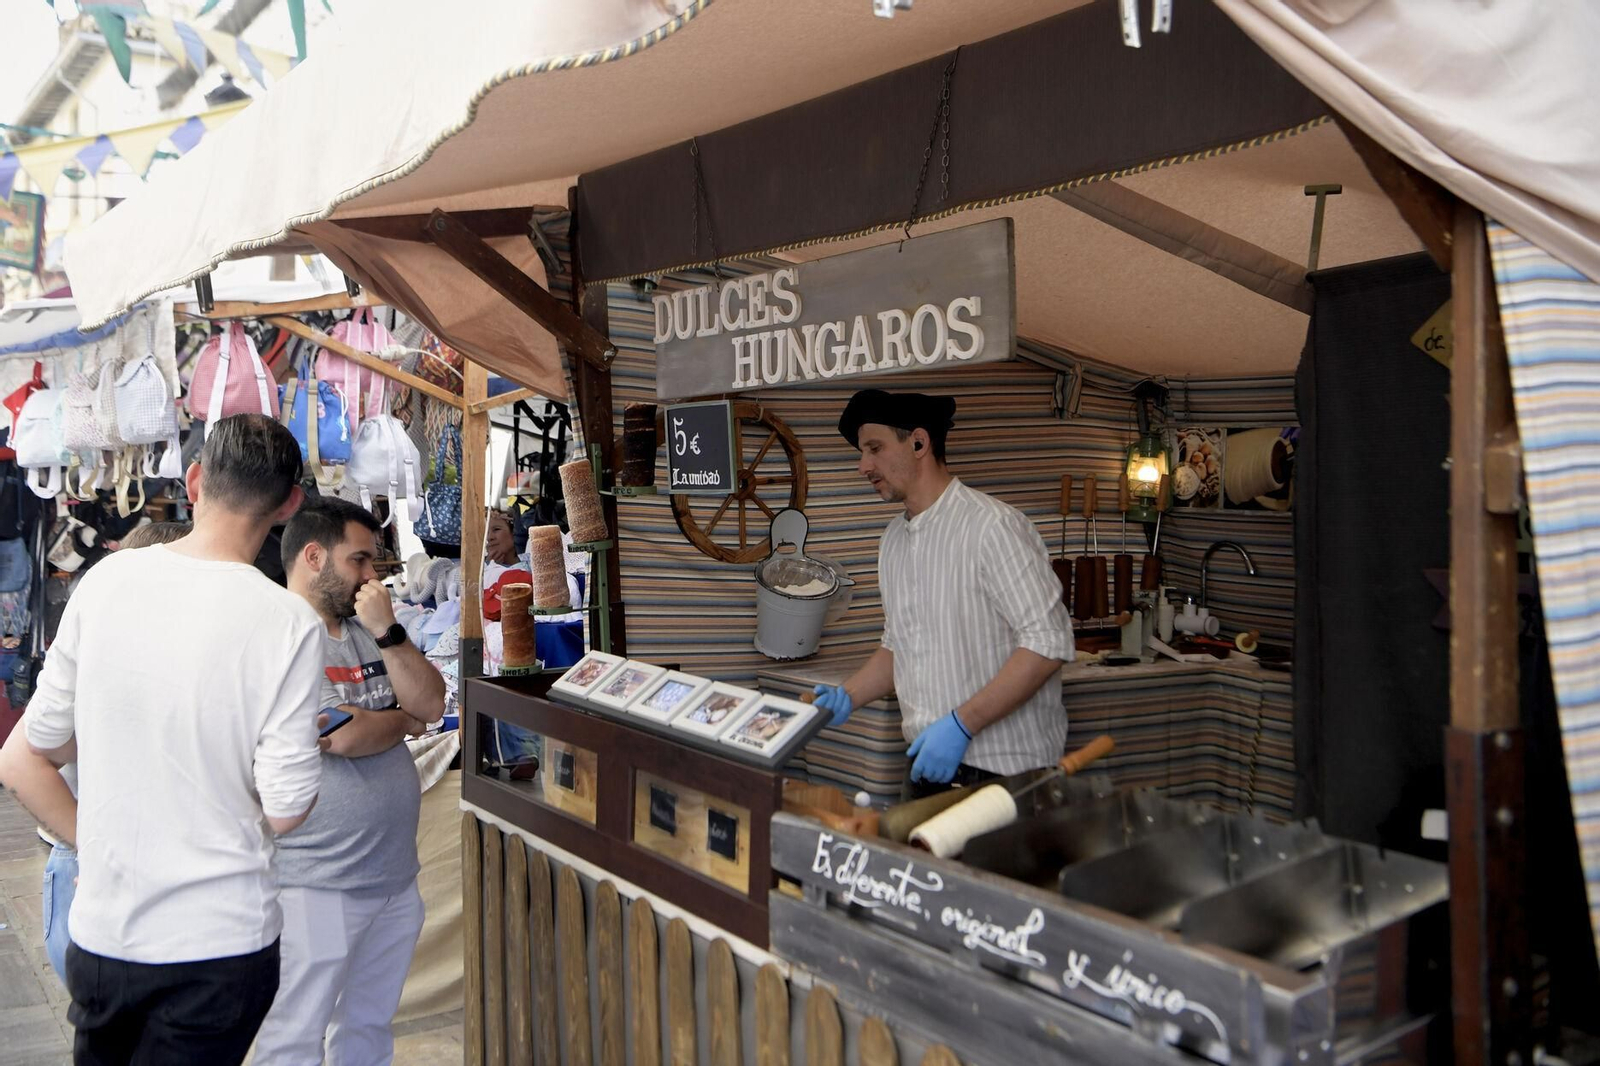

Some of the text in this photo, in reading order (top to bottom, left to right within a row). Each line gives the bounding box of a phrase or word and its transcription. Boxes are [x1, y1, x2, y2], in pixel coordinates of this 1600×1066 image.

[652, 268, 802, 344] DULCES
[732, 296, 985, 388] HUNGAROS
[812, 832, 834, 879] Es
